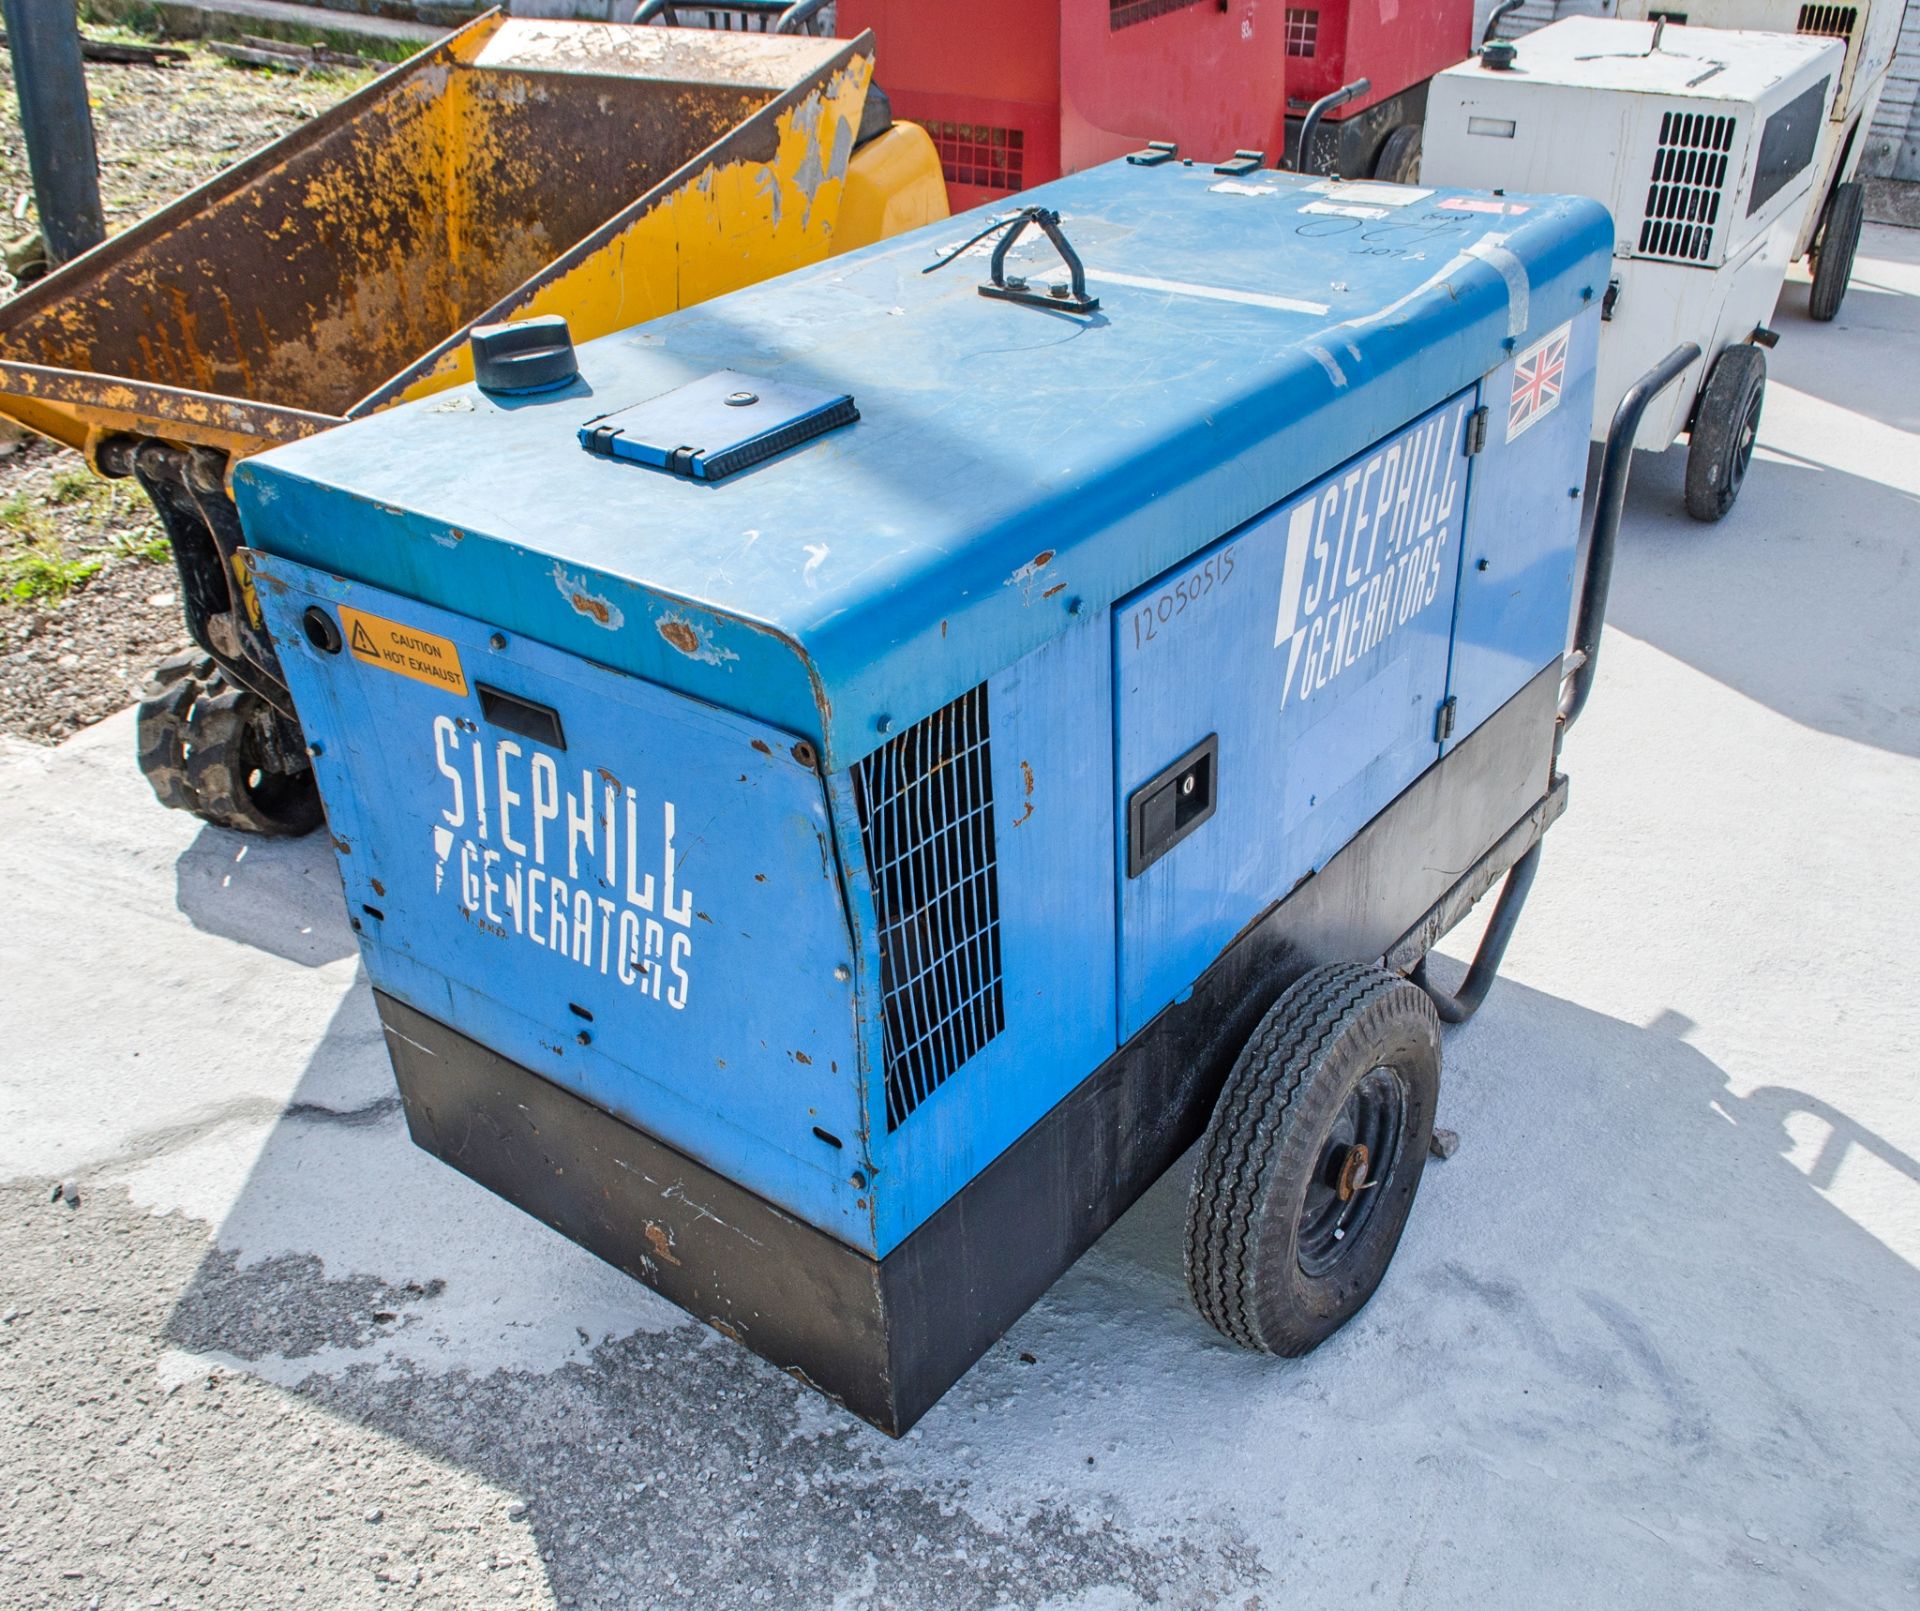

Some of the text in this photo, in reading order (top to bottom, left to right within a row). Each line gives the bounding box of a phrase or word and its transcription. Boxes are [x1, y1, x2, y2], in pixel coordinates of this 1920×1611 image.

[1304, 403, 1464, 616] STEPHILL
[383, 649, 461, 685] HOT EXHAUST
[391, 631, 442, 659] CAUTION
[1134, 546, 1236, 650] 12050515
[1300, 526, 1447, 701] GENERATORS
[433, 715, 692, 928] STEPHILL
[460, 839, 691, 1010] GENERATORS
